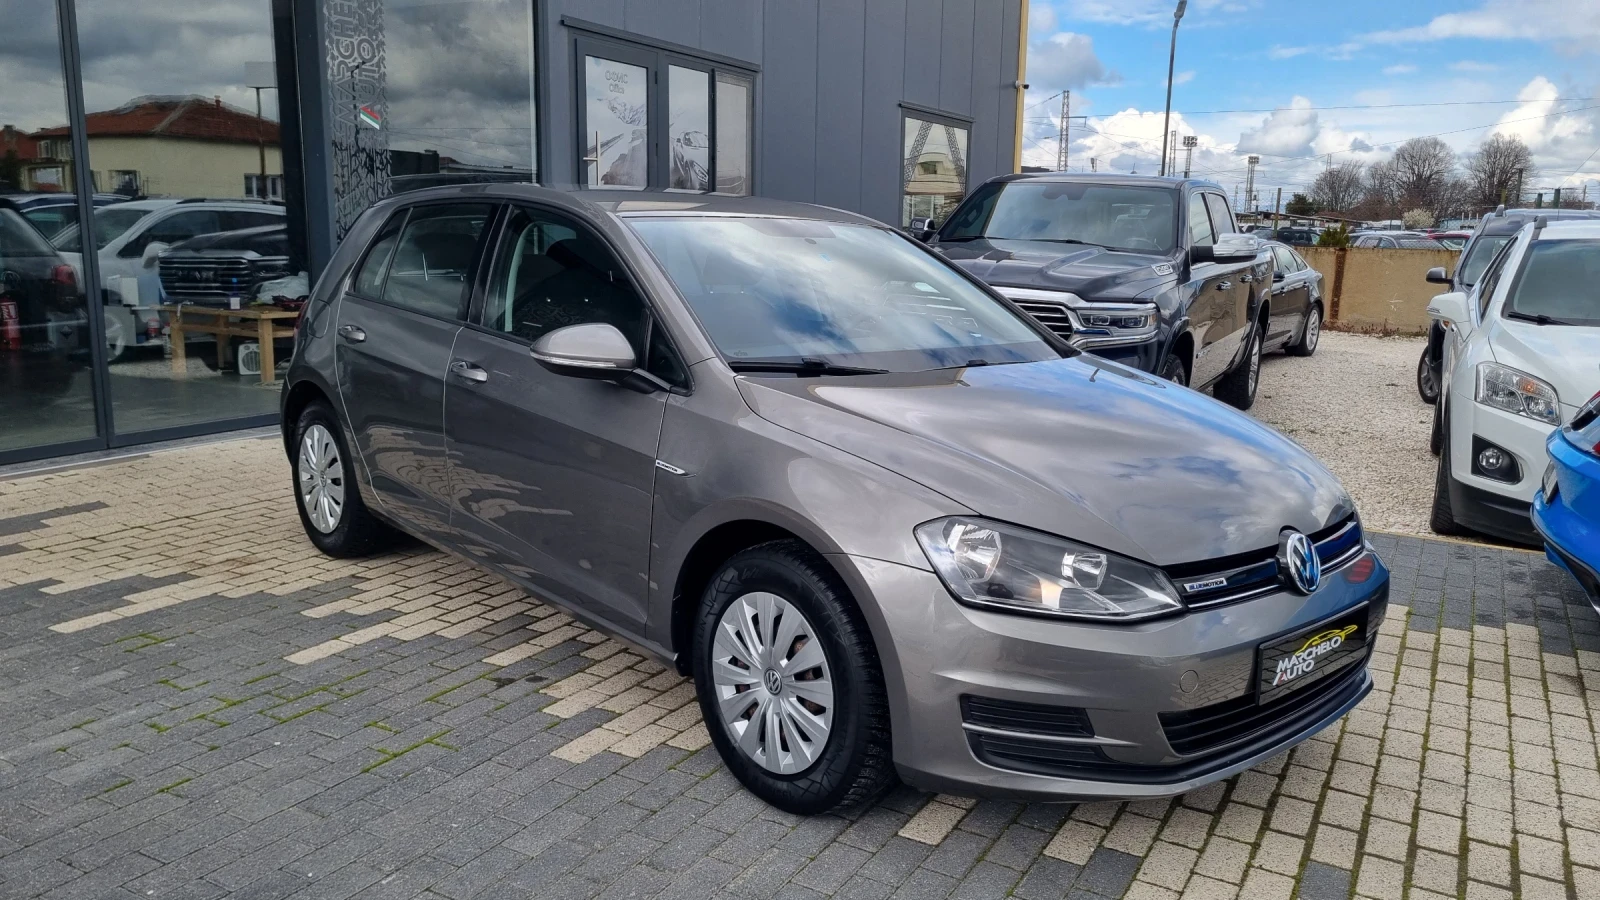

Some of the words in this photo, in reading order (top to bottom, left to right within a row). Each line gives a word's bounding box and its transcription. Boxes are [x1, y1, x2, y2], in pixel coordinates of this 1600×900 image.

[333, 0, 357, 125] MARCHE
[1272, 659, 1315, 687] AUTO
[1276, 636, 1342, 673] MARCHELO
